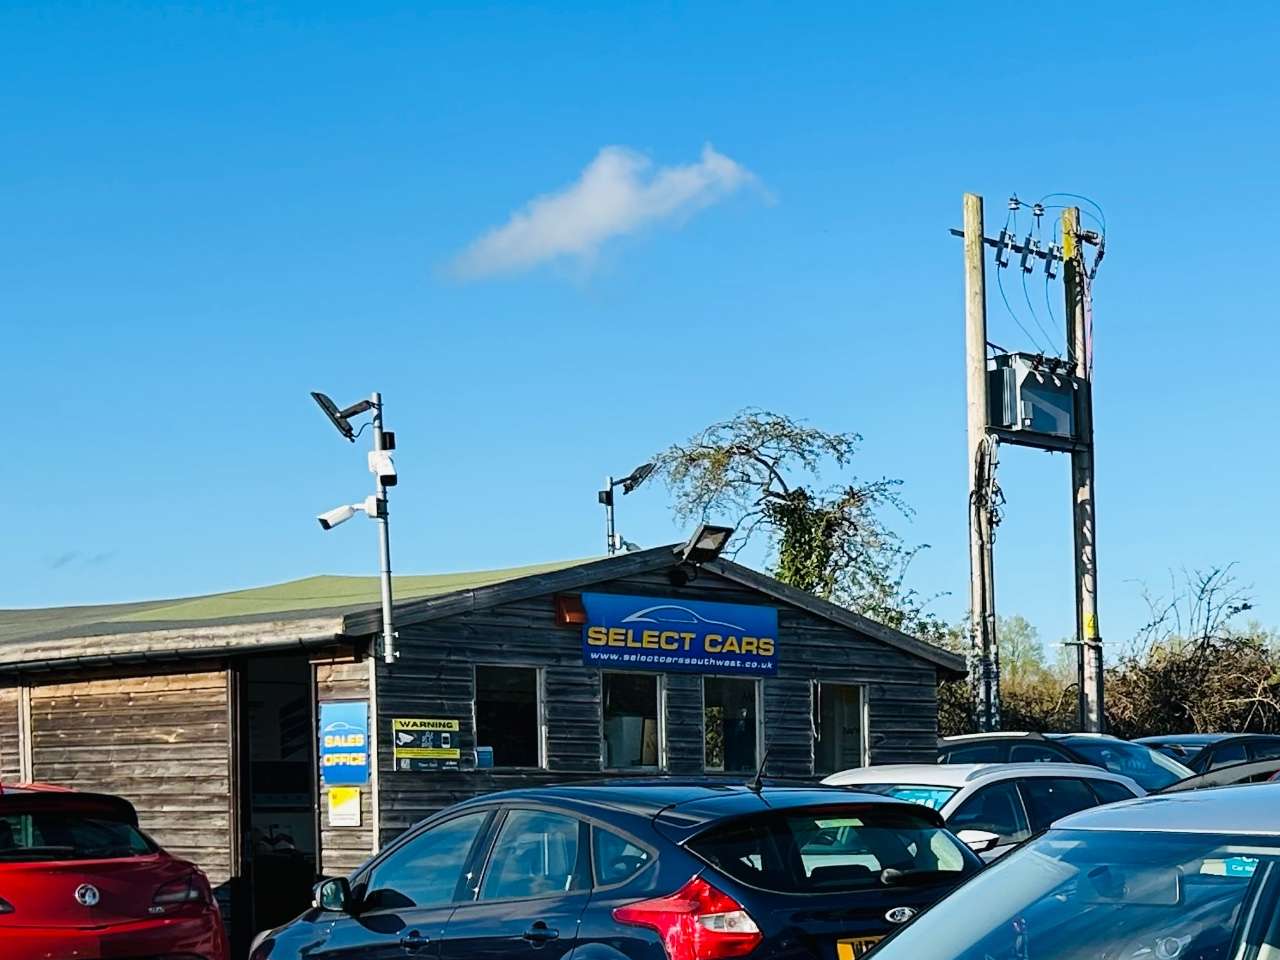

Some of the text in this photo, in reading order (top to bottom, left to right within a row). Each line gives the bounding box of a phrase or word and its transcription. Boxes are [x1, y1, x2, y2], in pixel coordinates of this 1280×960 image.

[587, 626, 775, 656] SELECT CARS
[590, 651, 773, 669] www.selectcarssouthwest.co.uk
[399, 720, 454, 729] WARNING
[325, 734, 364, 747] SALES
[324, 753, 366, 766] OFFICE
